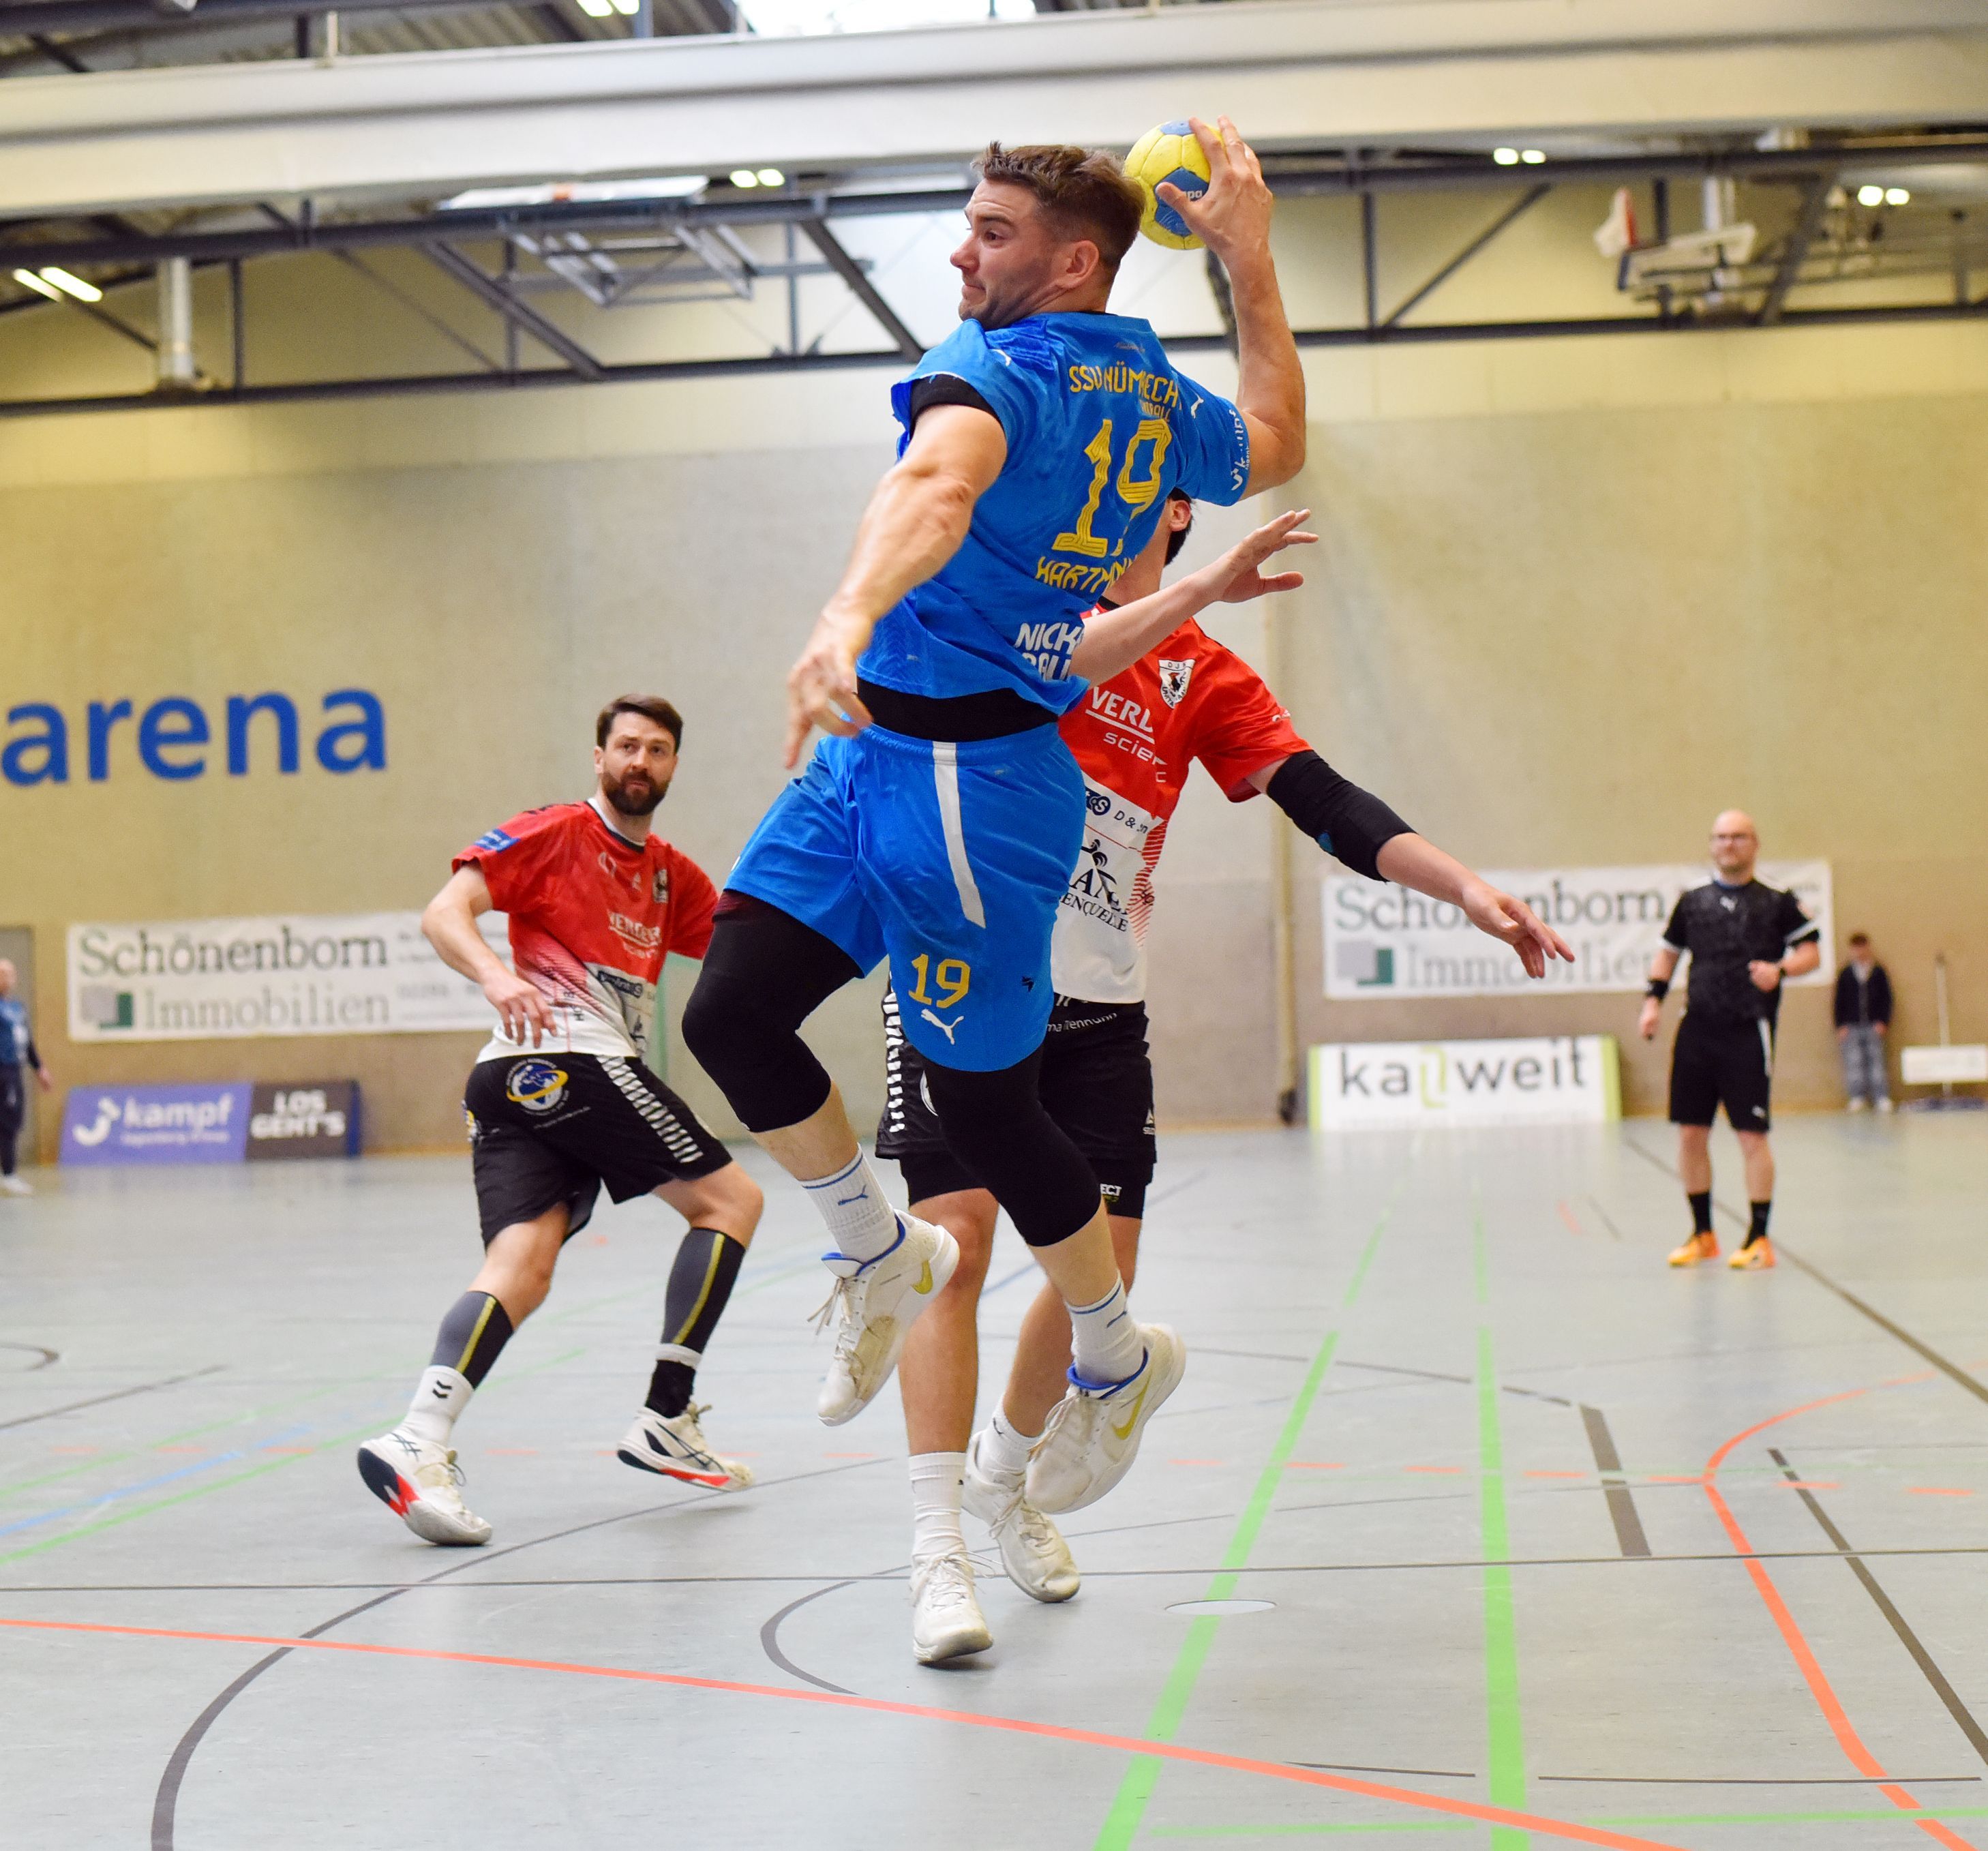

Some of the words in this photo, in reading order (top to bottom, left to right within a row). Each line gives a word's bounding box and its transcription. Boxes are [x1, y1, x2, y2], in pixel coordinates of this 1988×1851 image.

[1051, 419, 1173, 558] 19
[1, 687, 388, 787] arena
[80, 925, 389, 976] Schönenborn
[145, 982, 389, 1029] Immobilien
[908, 953, 971, 1008] 19
[123, 1093, 232, 1134] kampf
[274, 1089, 327, 1114] LOS
